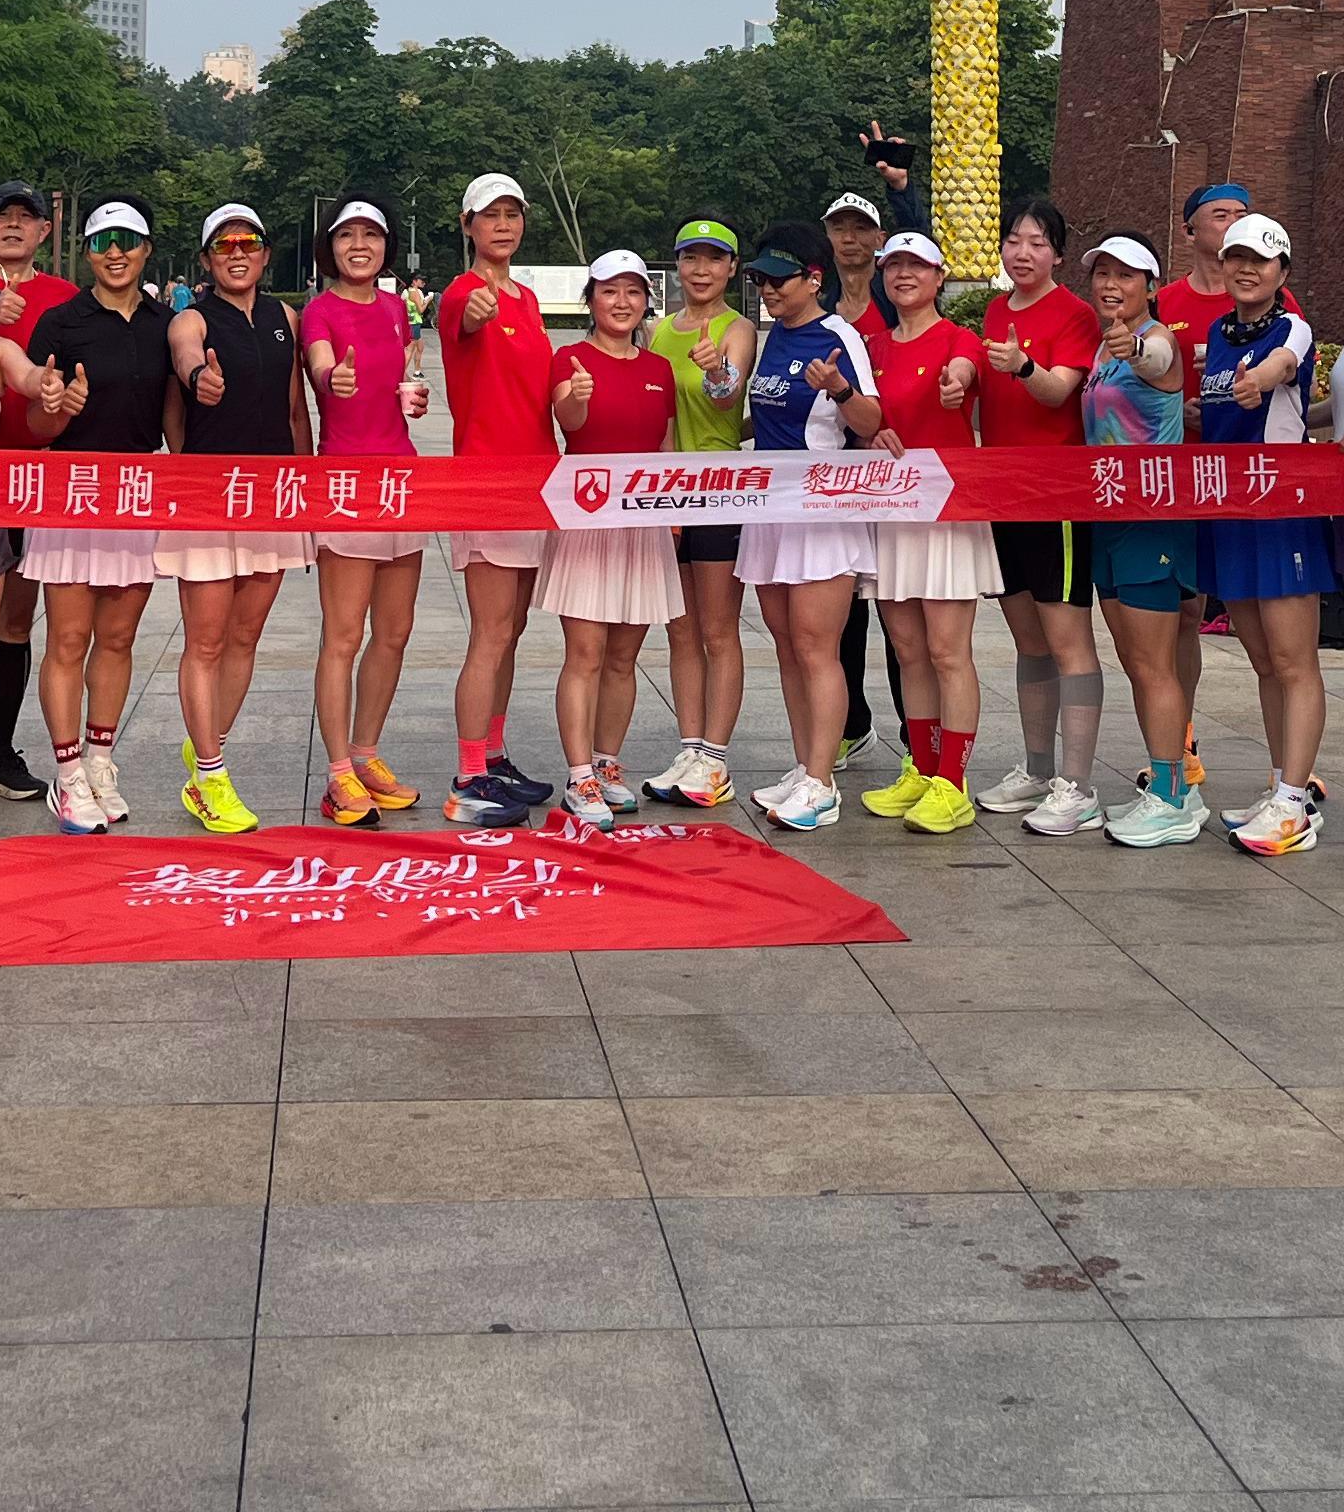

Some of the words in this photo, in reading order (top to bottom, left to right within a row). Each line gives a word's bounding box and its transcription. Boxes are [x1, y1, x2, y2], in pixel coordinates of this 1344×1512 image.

[622, 466, 774, 494] 力为体育
[801, 459, 922, 496] 黎明脚步
[802, 498, 919, 511] www.limingjiaobu.net
[930, 726, 942, 754] SPORT
[960, 739, 974, 769] SPORT
